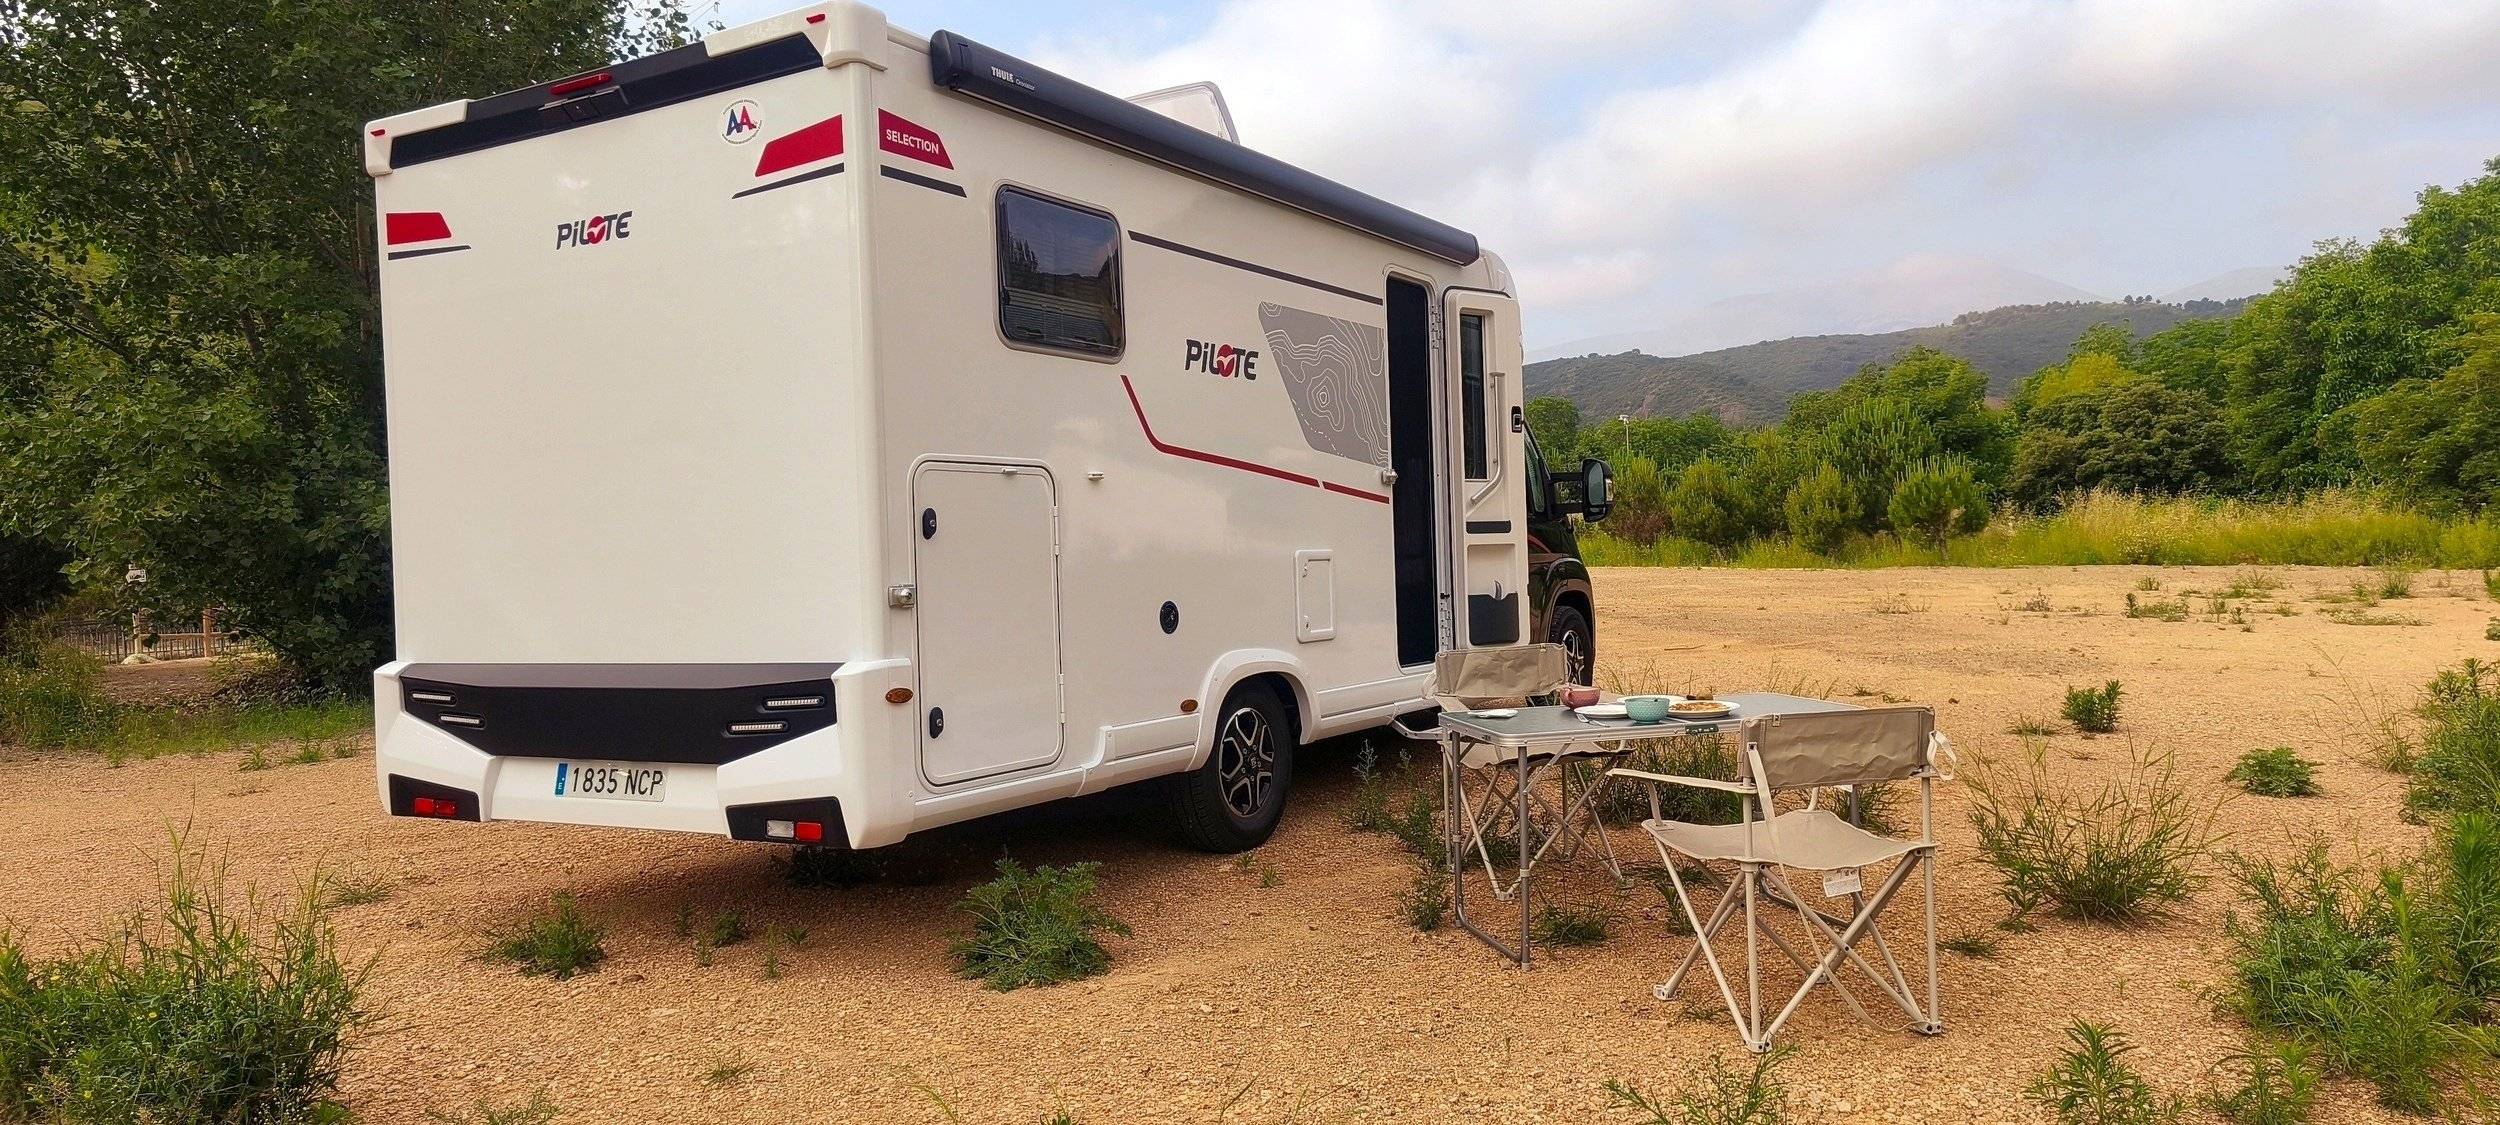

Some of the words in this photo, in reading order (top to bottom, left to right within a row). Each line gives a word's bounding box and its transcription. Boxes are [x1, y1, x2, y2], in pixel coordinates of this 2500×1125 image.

[991, 66, 1014, 83] THULE
[886, 129, 939, 154] SELECTION
[573, 767, 619, 794] 1835
[624, 769, 664, 796] NCP
